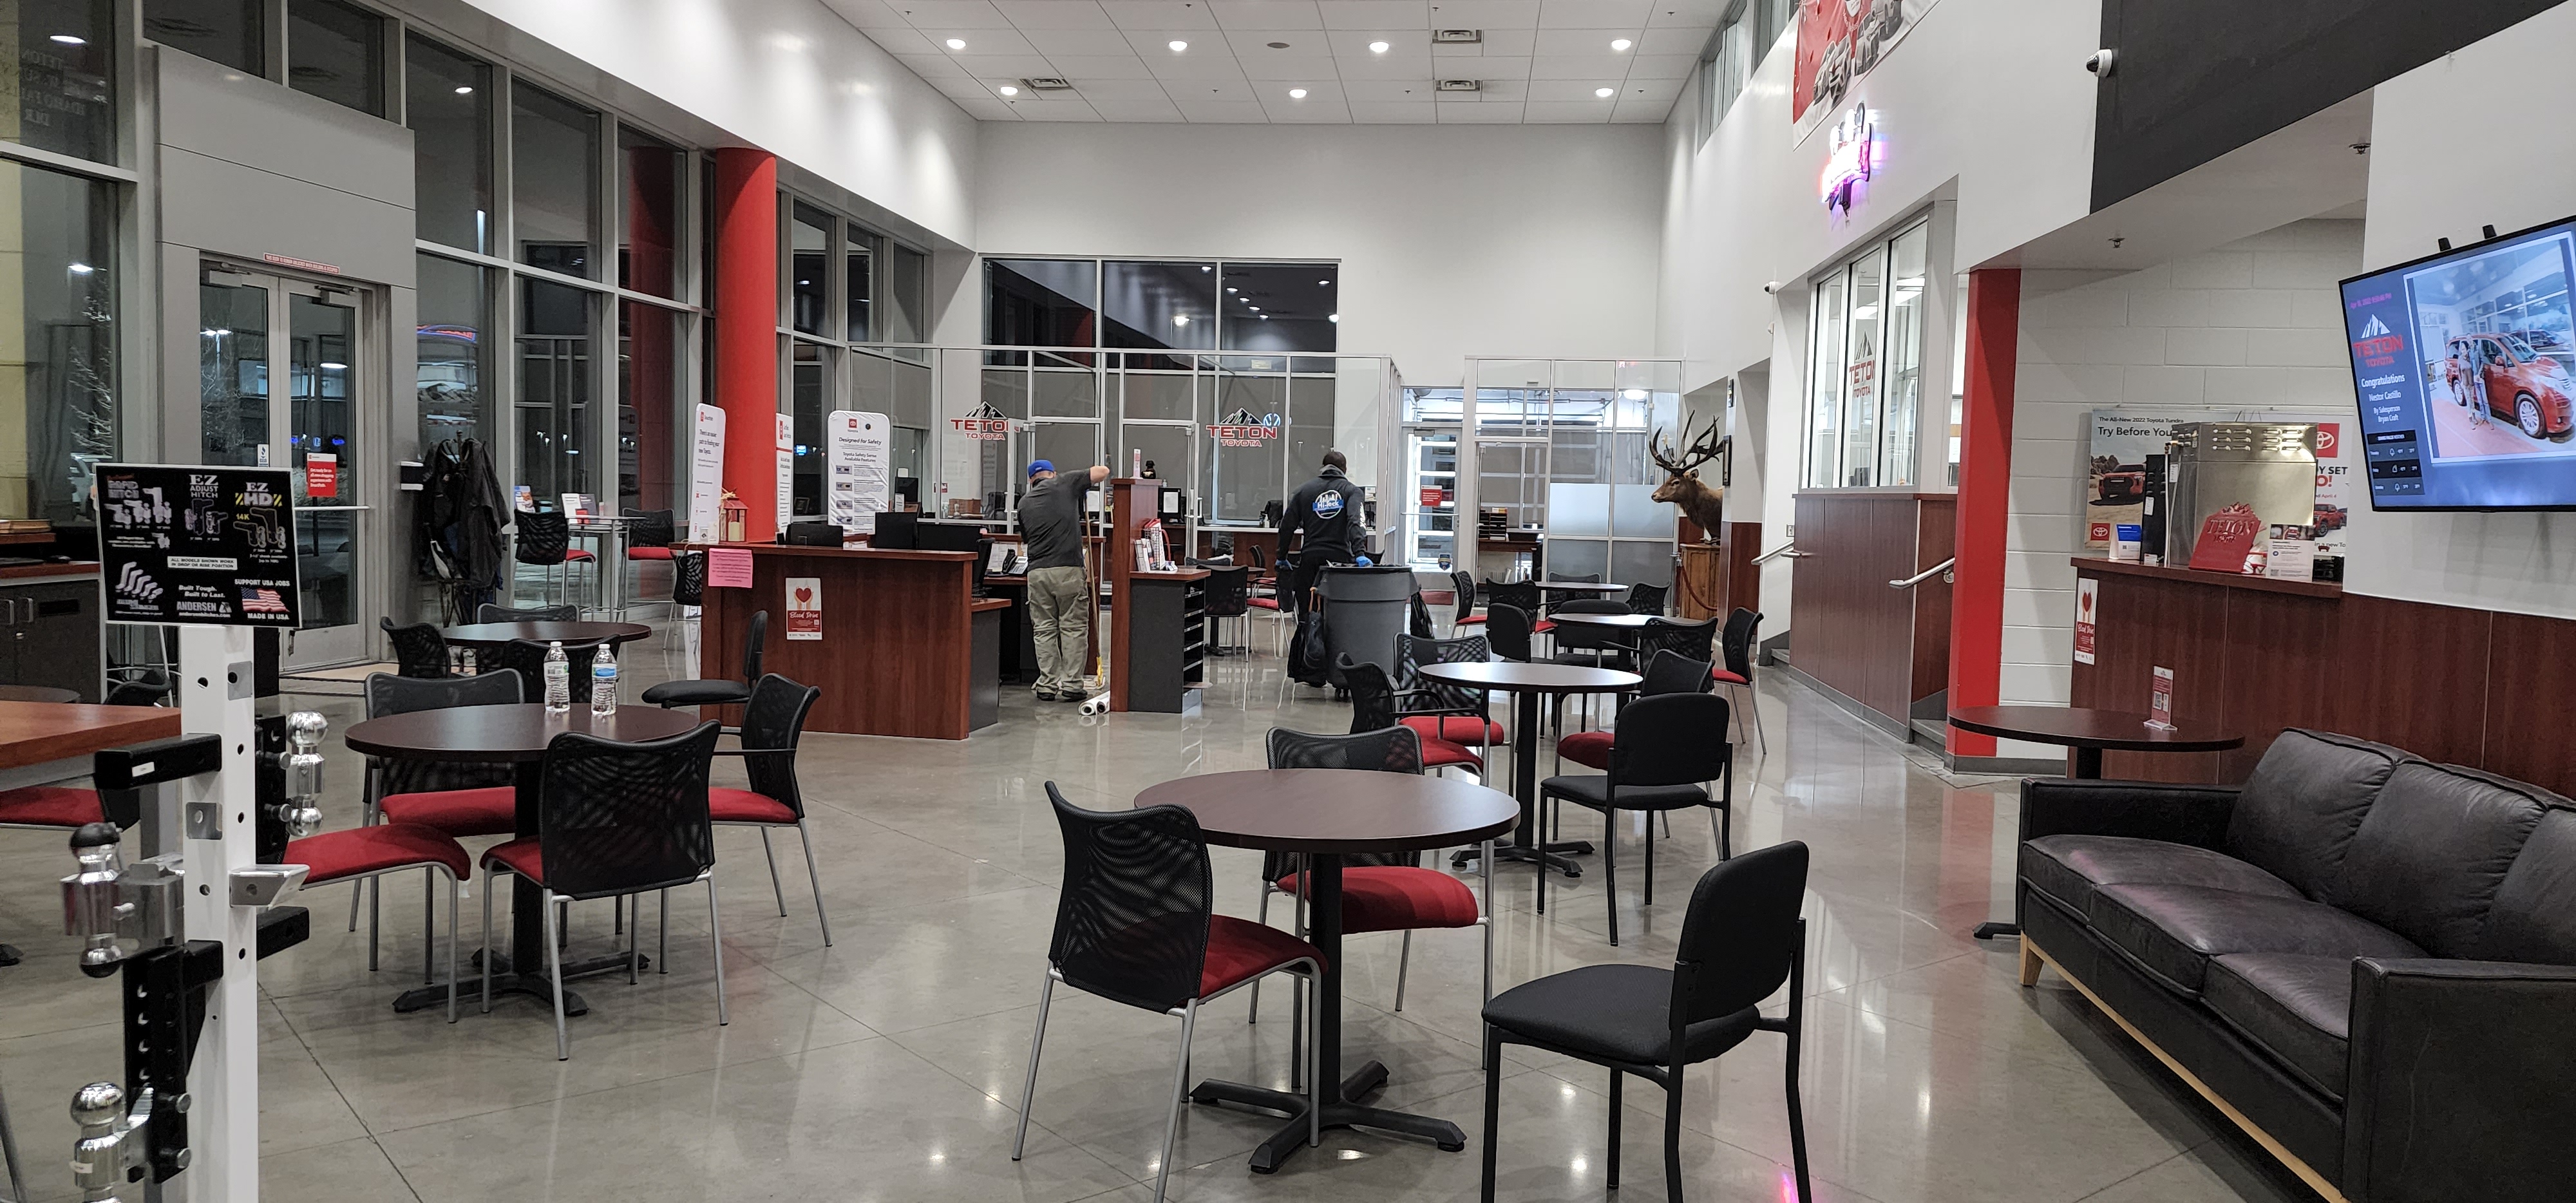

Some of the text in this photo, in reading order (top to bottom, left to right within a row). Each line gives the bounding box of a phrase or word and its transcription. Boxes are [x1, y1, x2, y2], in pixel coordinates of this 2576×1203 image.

[2353, 334, 2403, 357] TETON
[2361, 374, 2405, 389] Congratulations
[1854, 385, 1871, 398] TOYOTA
[965, 432, 1005, 440] TOYOTA
[1206, 425, 1277, 439] TETON
[2098, 426, 2114, 437] Try
[2116, 426, 2150, 437] Before
[2328, 466, 2348, 475] SET
[189, 475, 218, 486] EZ
[246, 482, 269, 492] EZ
[243, 493, 273, 506] HD
[2207, 519, 2256, 536] TETON
[176, 602, 216, 612] ANDERSEN
